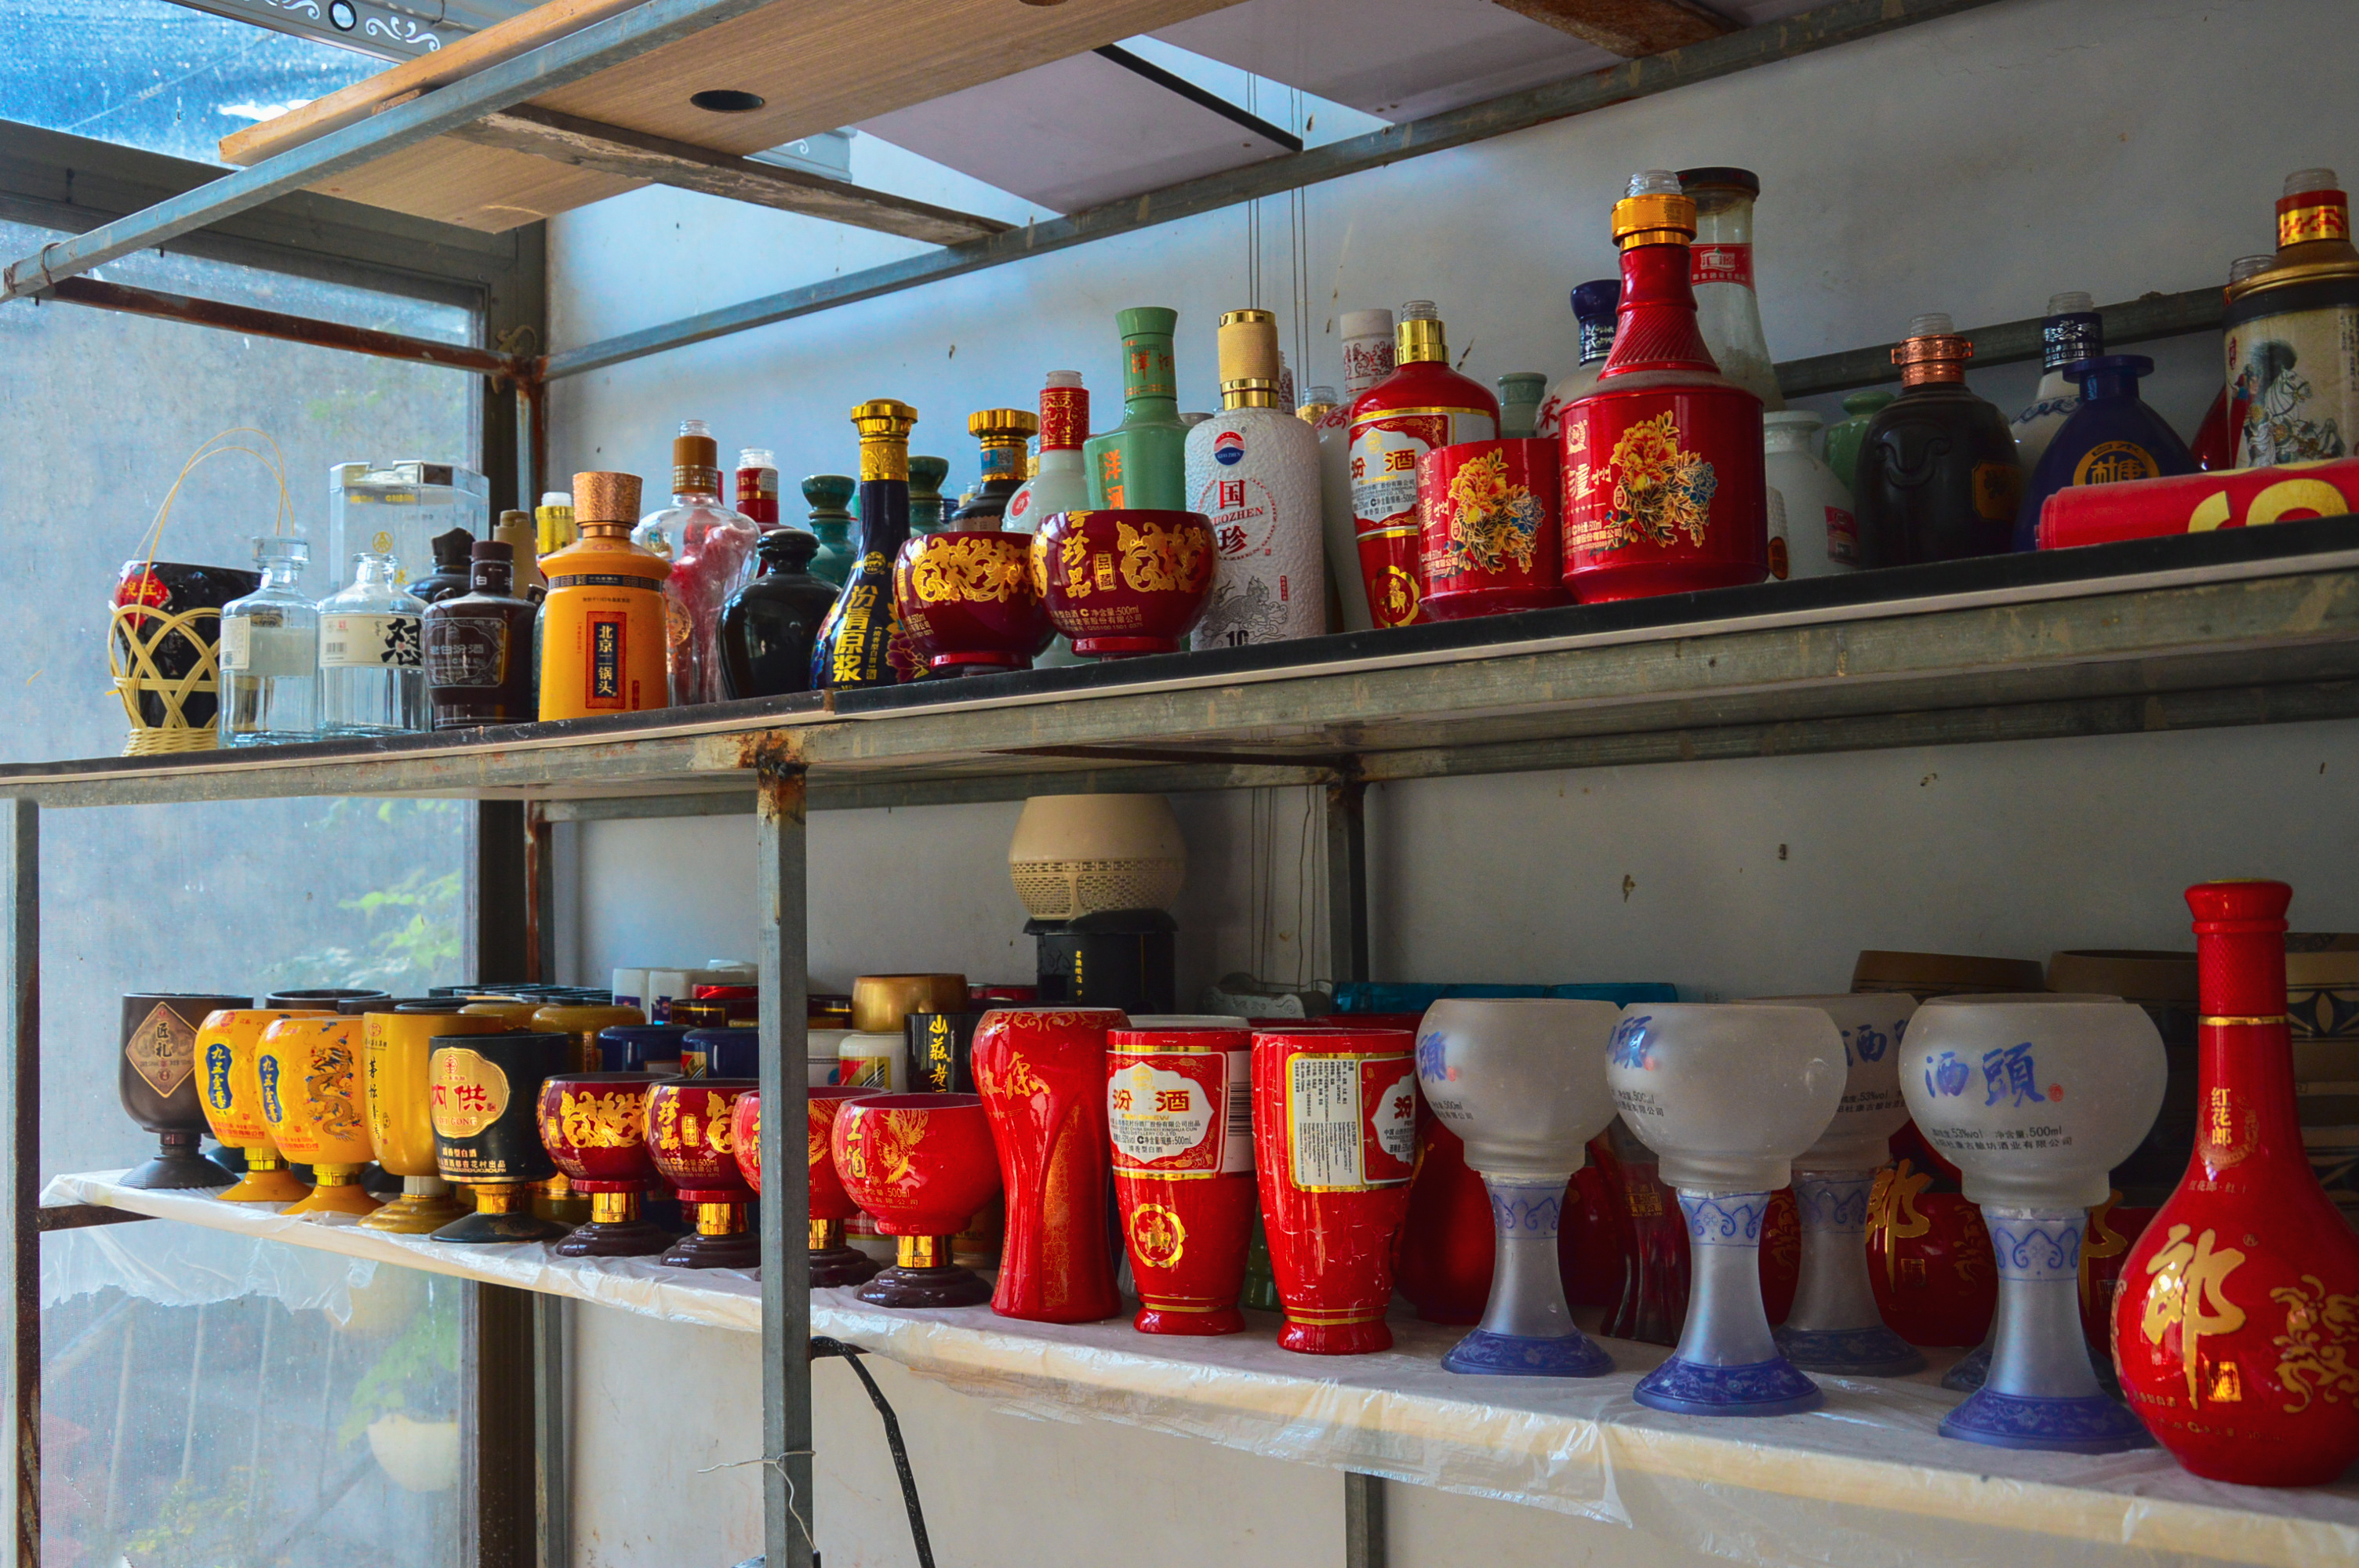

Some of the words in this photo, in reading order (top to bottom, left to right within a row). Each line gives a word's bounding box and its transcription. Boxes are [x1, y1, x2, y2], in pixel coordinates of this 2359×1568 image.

[1350, 449, 1416, 480] 汾酒
[1219, 478, 1245, 509] 国
[1211, 506, 1264, 525] UOZHEN
[1219, 525, 1248, 555] 珍
[833, 585, 879, 682] 汾清原浆
[598, 625, 614, 695] 北京二锅头
[156, 1022, 173, 1058] 匠礼
[1925, 1042, 2046, 1109] 酒頭
[431, 1083, 488, 1112] 内供
[1112, 1088, 1190, 1113] 汾酒
[450, 1116, 478, 1126] GONG
[1994, 1126, 2063, 1139] 净含量:500ml
[2211, 1087, 2232, 1147] 红花郎
